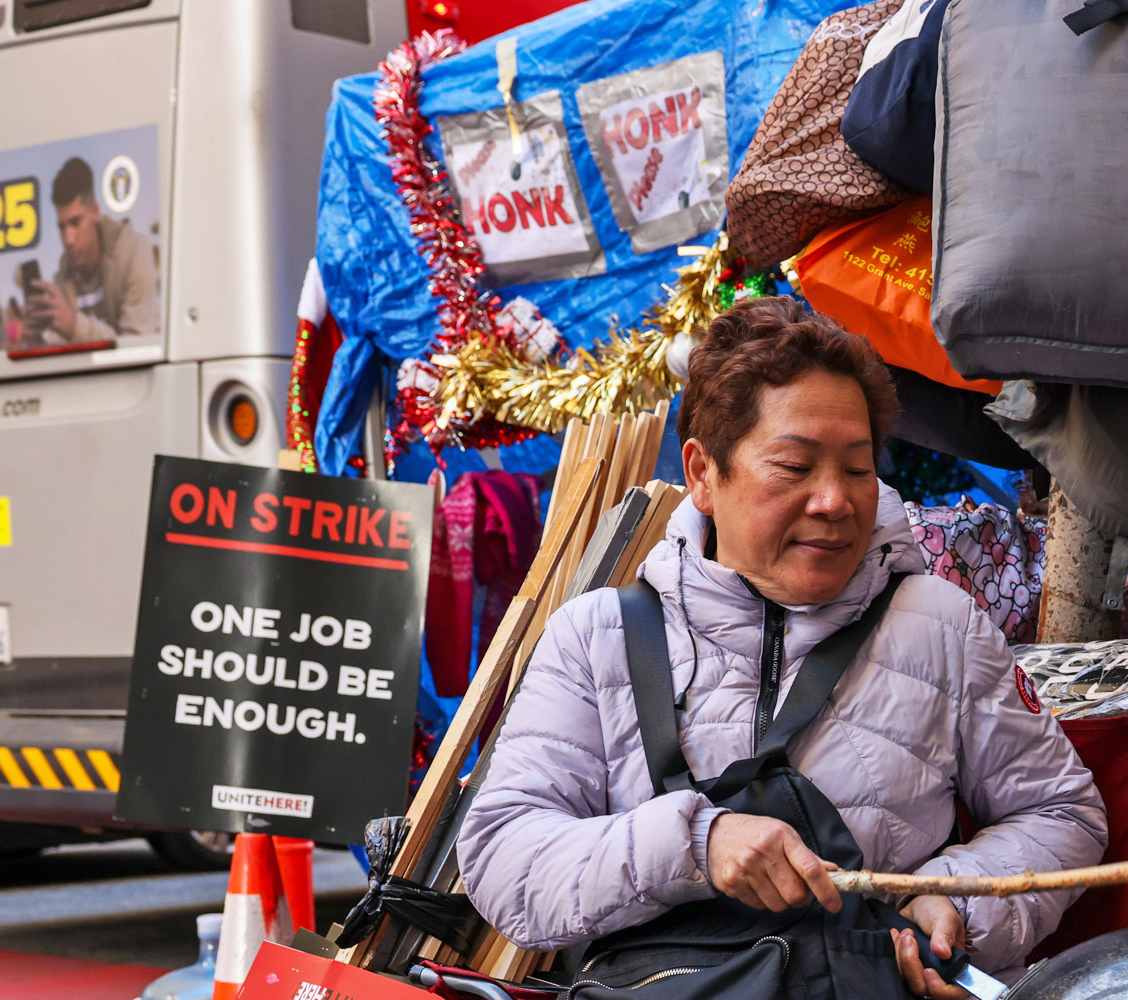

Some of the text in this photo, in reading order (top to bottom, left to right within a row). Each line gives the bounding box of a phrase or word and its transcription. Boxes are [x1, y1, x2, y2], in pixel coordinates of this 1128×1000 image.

[602, 90, 703, 155] HONK
[0, 182, 37, 249] 5
[463, 185, 575, 236] HONK
[843, 250, 866, 268] 1122
[866, 263, 895, 282] Grant
[894, 278, 916, 292] Ave.
[872, 246, 902, 272] Tel:
[169, 483, 413, 550] ON STRIKE
[190, 601, 373, 650] ONE JOB
[158, 644, 395, 700] SHOULD BE
[175, 694, 367, 745] ENOUGH.
[218, 790, 308, 812] UNITEHERE!
